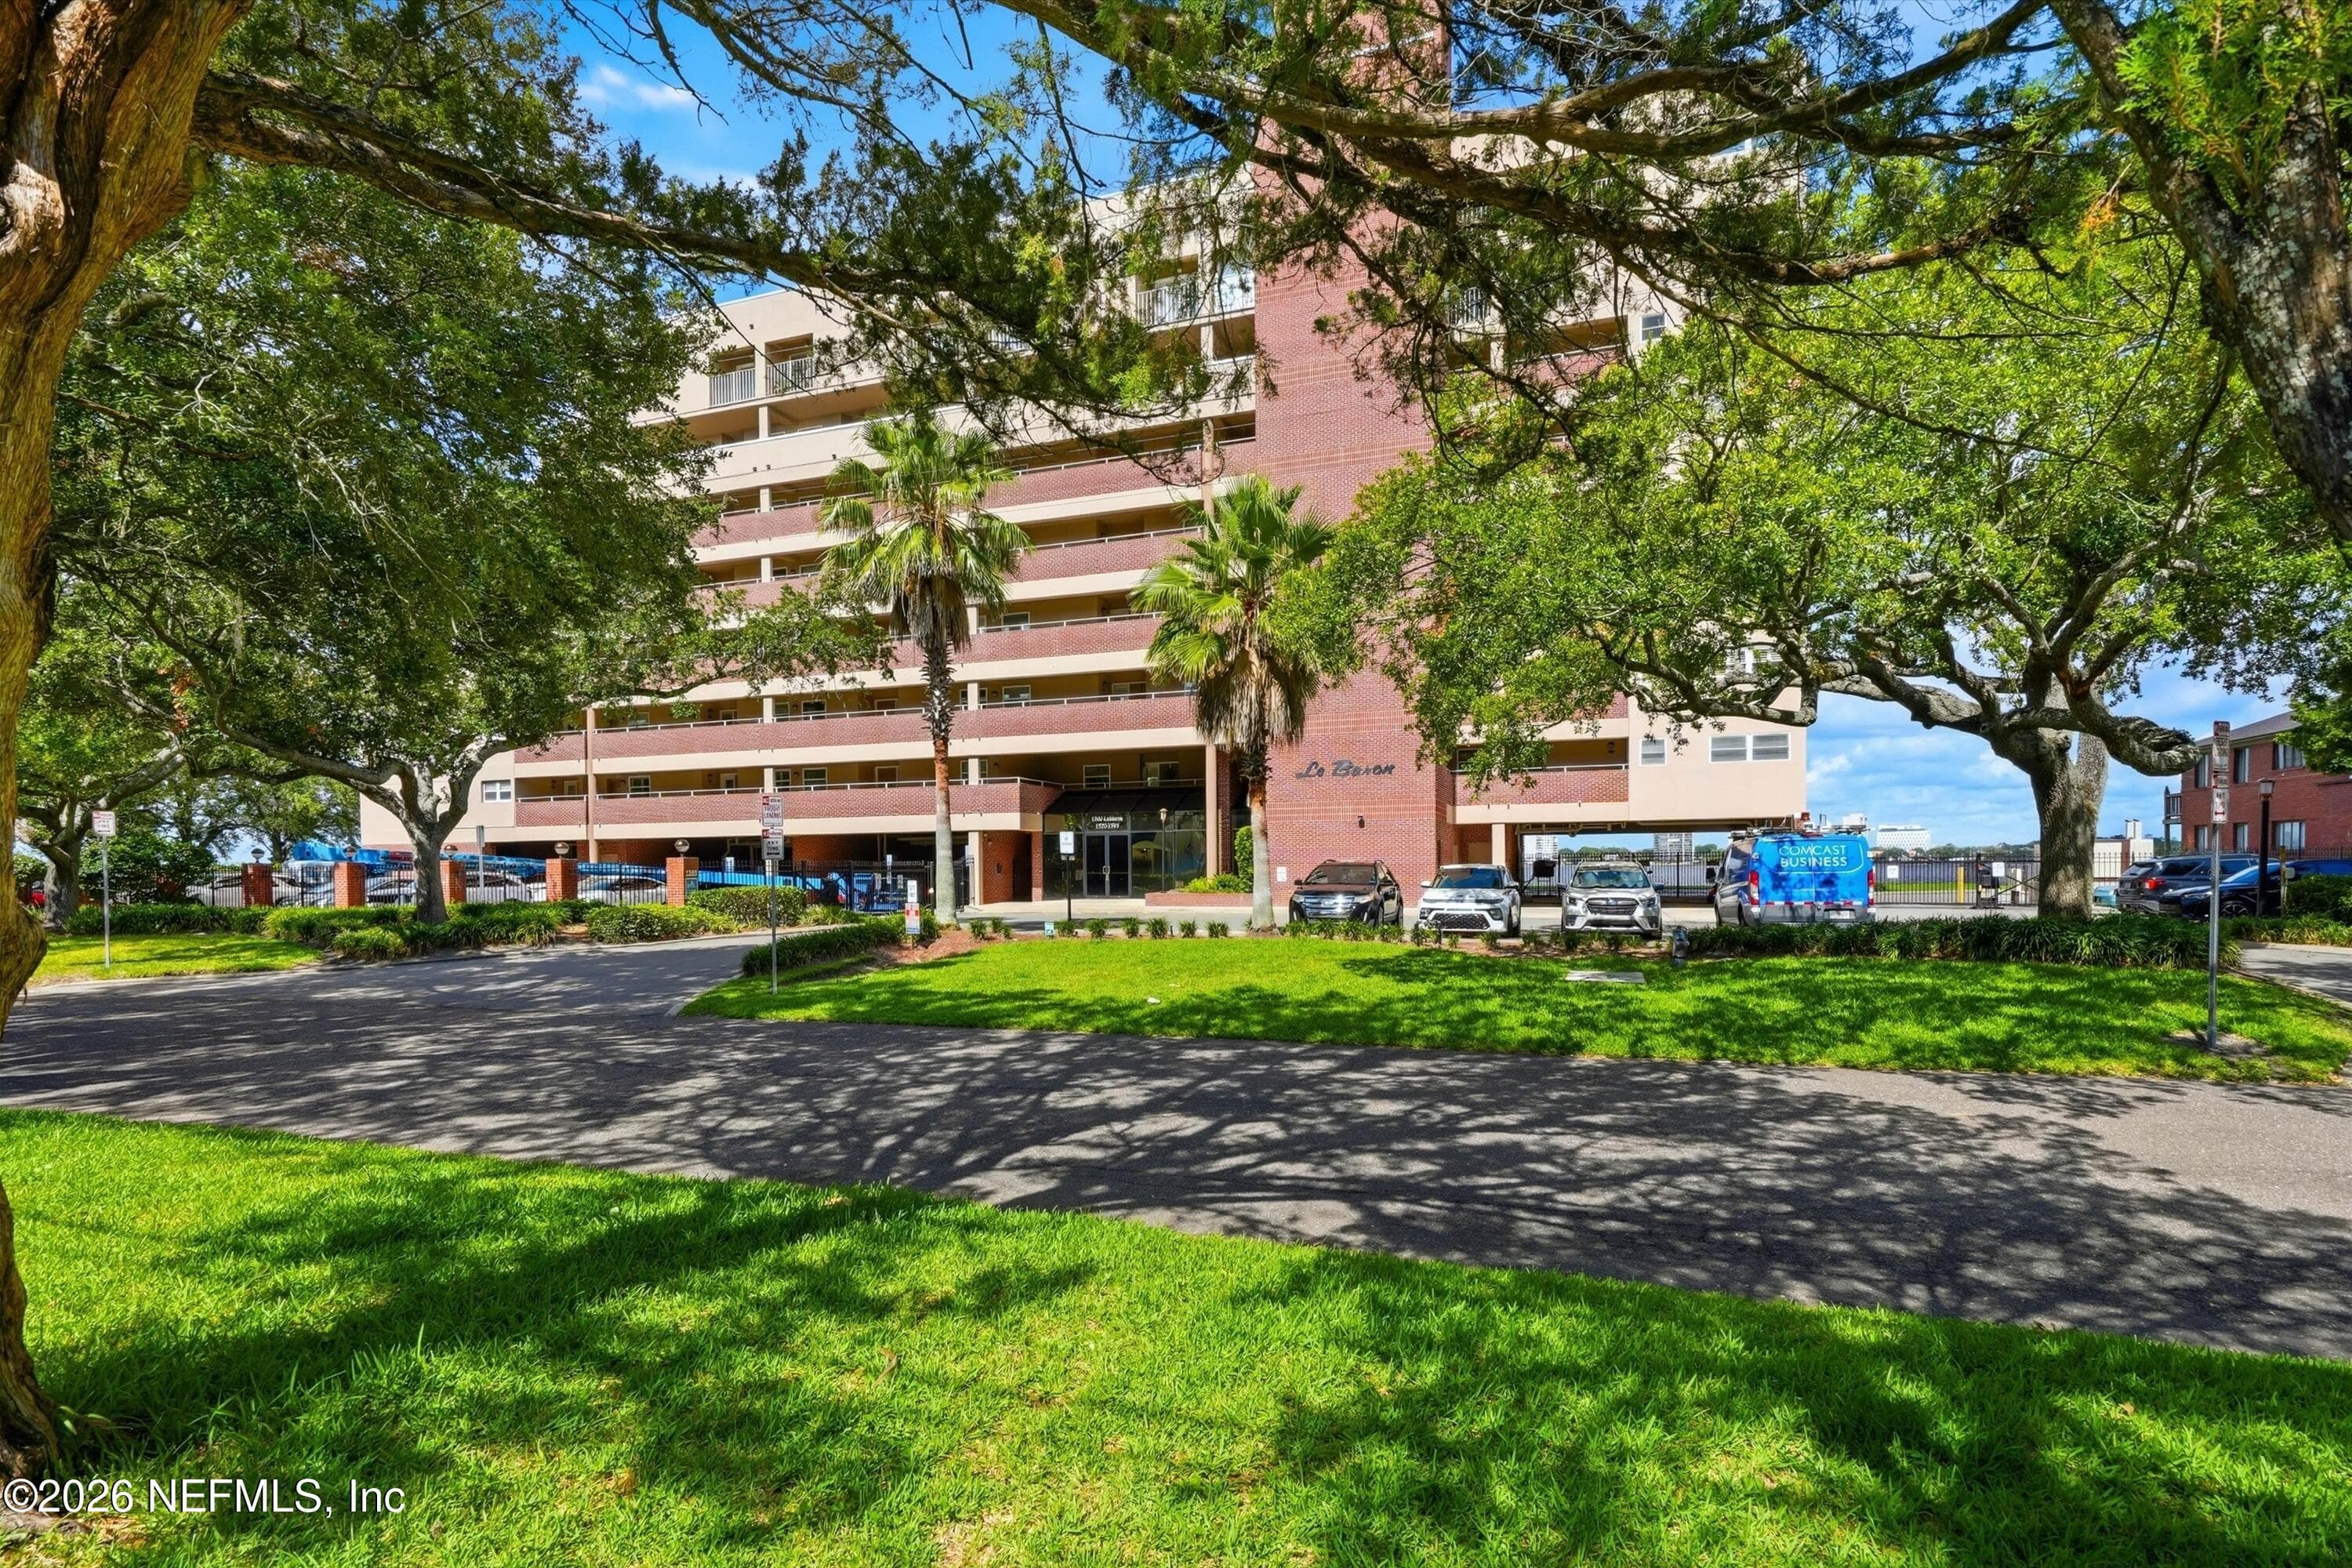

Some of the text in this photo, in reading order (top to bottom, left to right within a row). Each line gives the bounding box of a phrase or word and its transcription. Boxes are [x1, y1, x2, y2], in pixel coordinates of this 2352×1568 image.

[1332, 759, 1396, 778] Baron
[1779, 844, 1847, 856] COMCAST
[1780, 856, 1848, 868] BUSINESS
